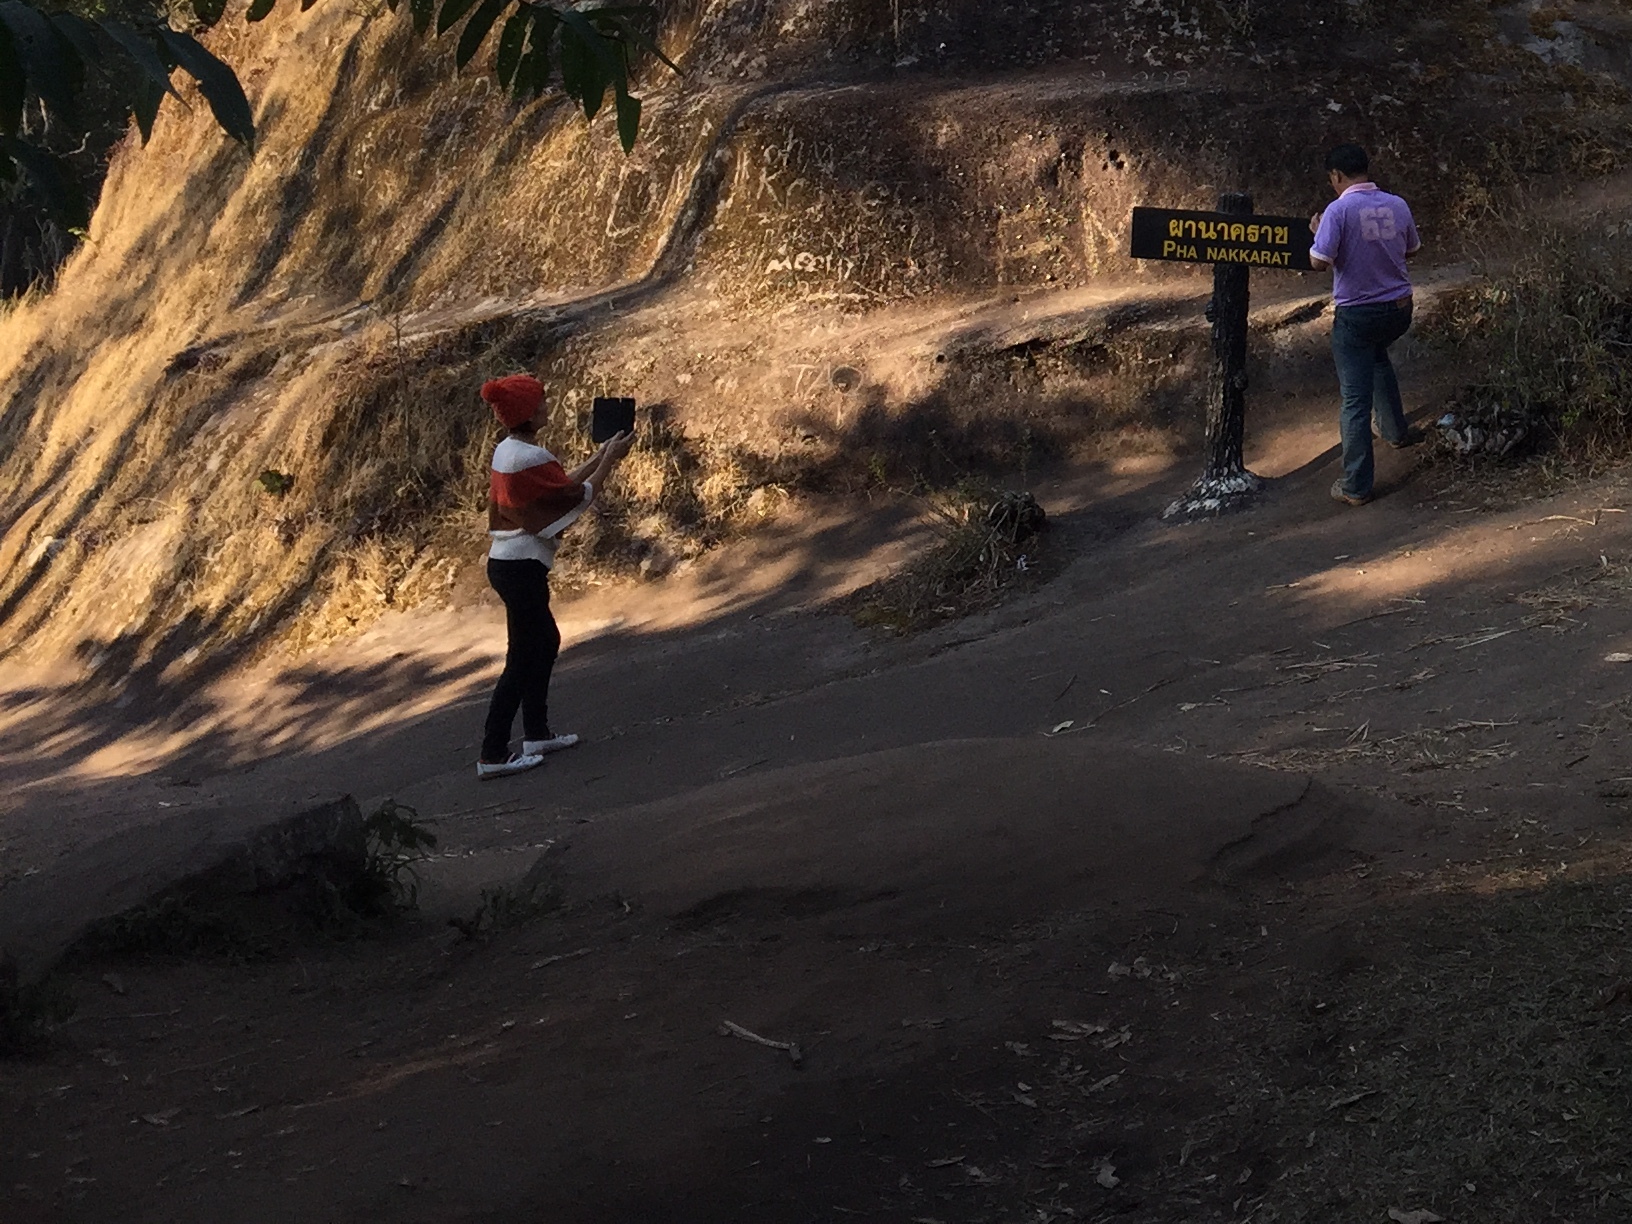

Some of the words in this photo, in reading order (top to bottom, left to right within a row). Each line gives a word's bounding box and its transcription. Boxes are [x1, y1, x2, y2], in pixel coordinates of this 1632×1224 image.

[1169, 218, 1289, 245] ผานาคราช
[1163, 240, 1198, 259] PHA
[1206, 247, 1292, 265] NAKKARAT
